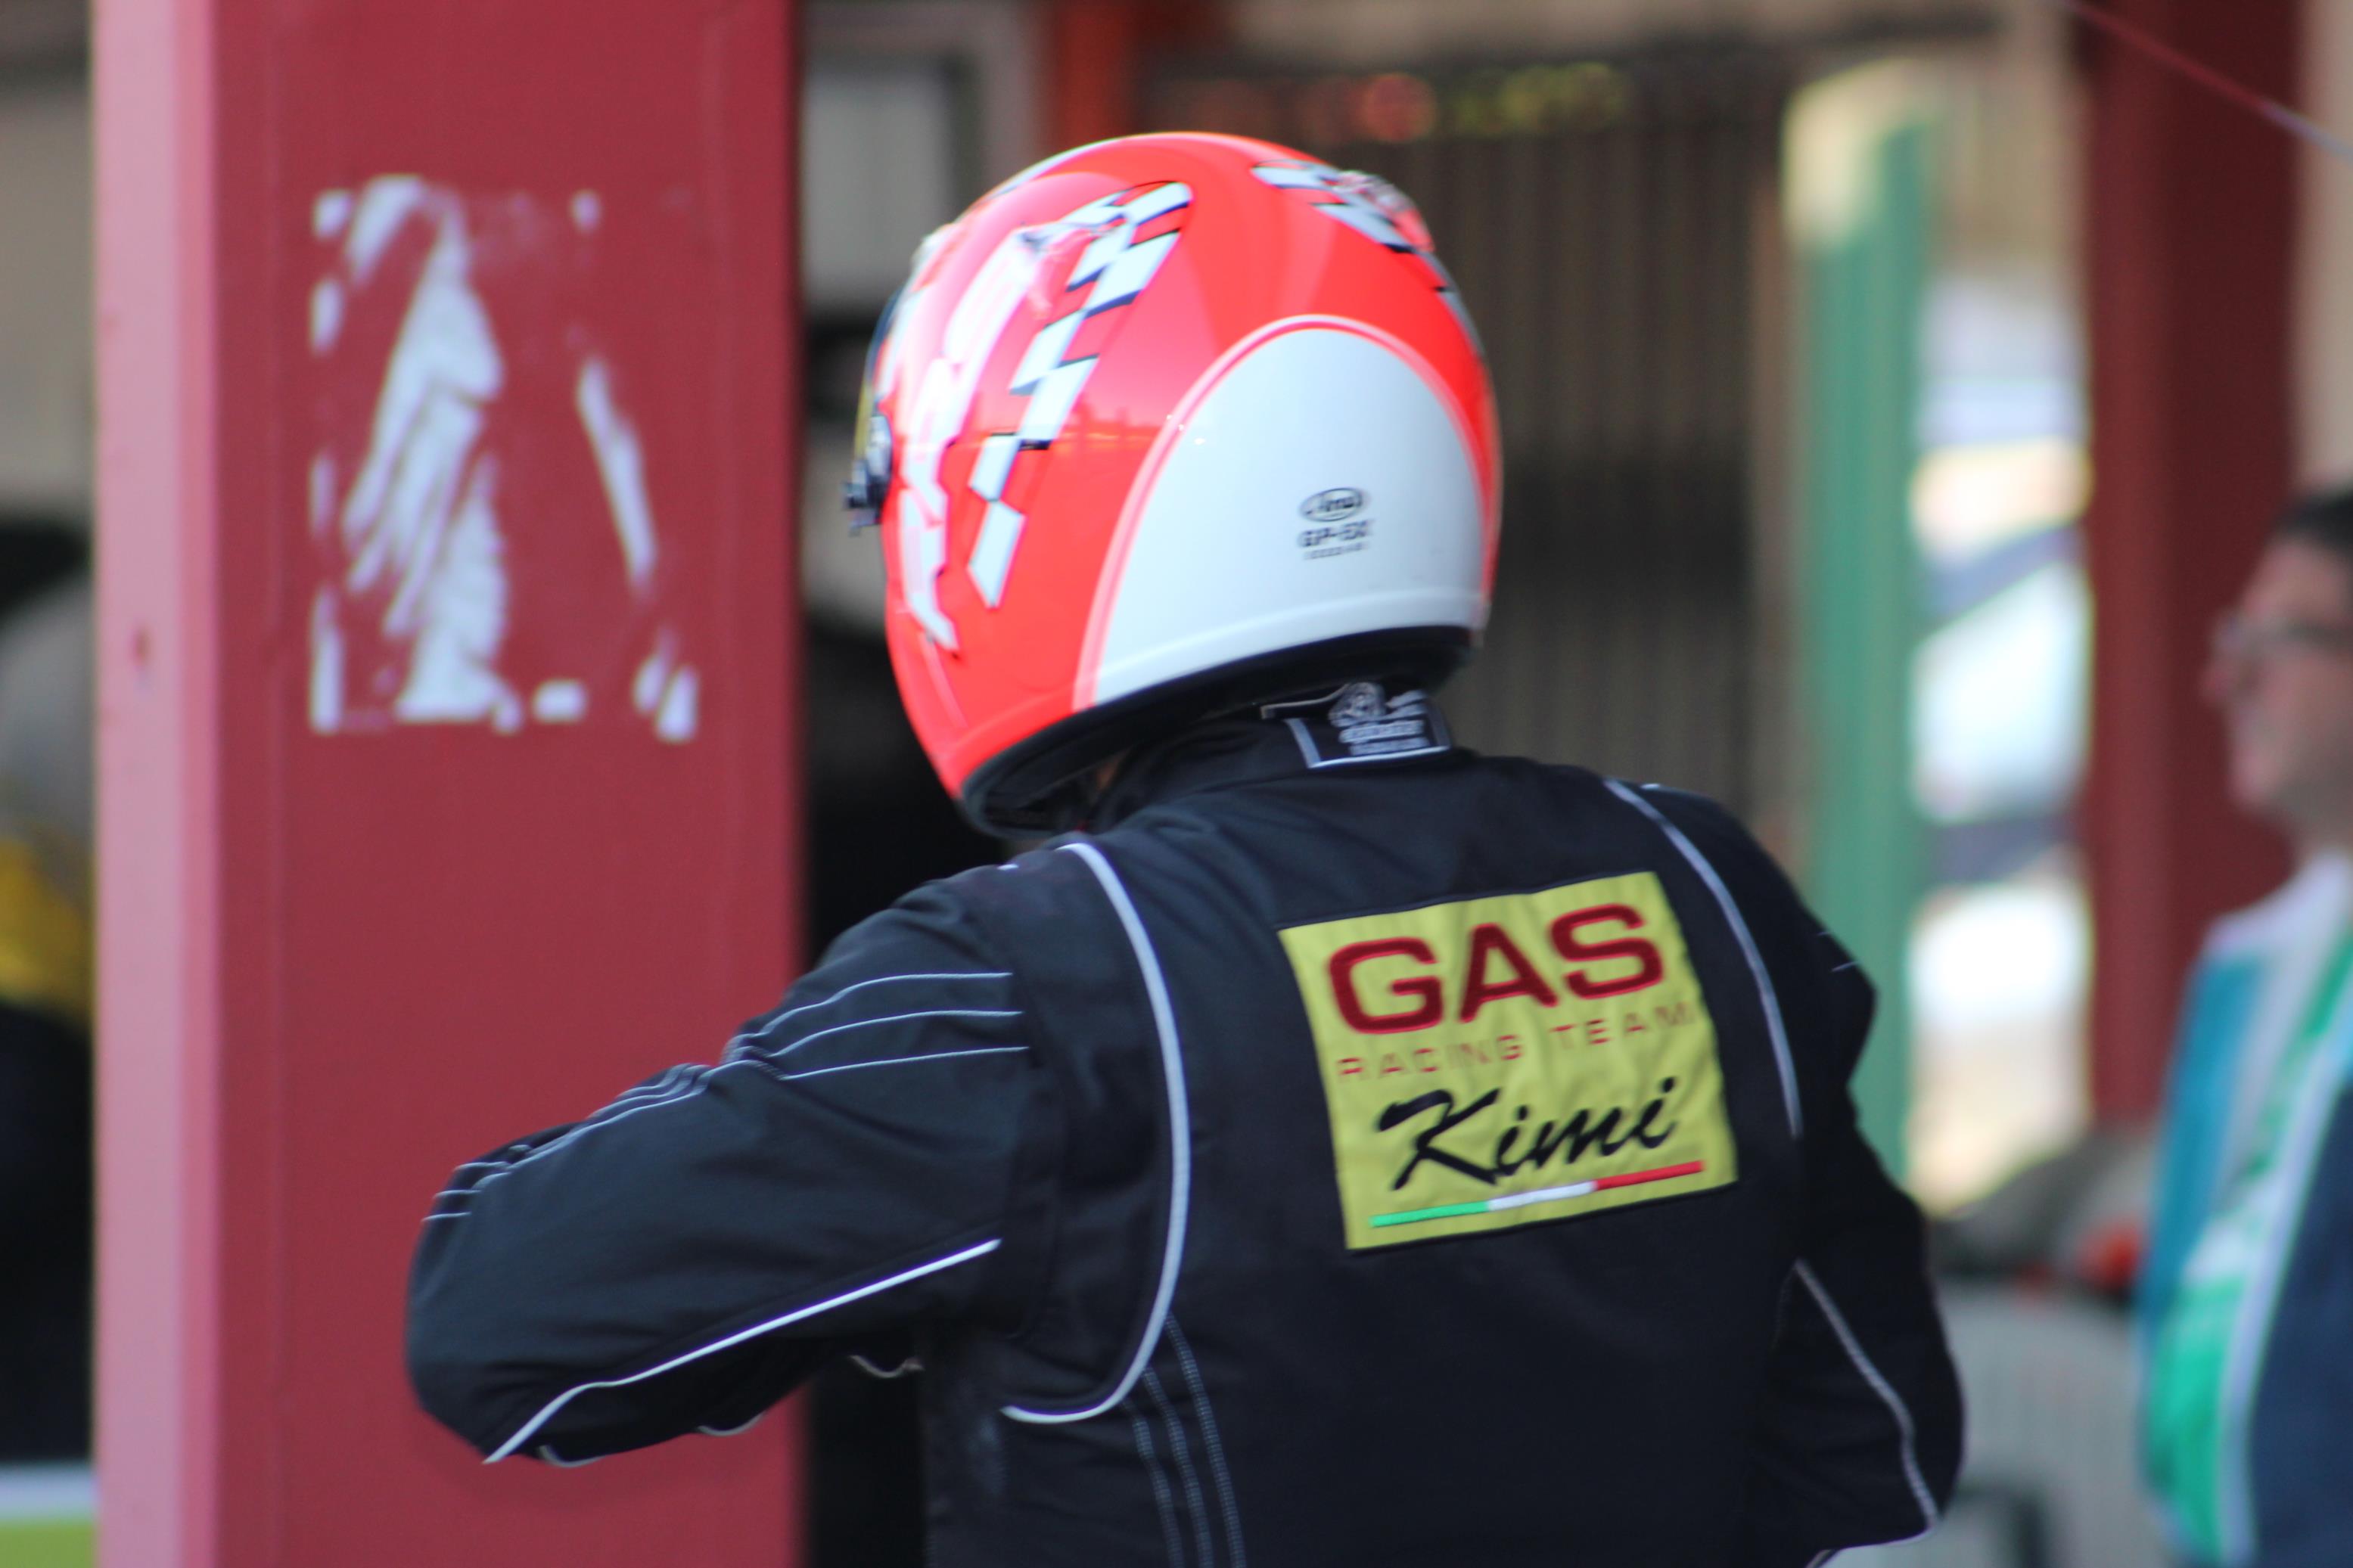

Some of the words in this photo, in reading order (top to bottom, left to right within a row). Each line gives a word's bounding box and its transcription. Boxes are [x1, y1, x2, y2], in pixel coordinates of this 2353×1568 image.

[1327, 903, 1664, 1034] GAS
[1338, 1035, 1522, 1082] RACING
[1549, 1001, 1695, 1050] TEAM
[1374, 1076, 1677, 1191] Kimi
